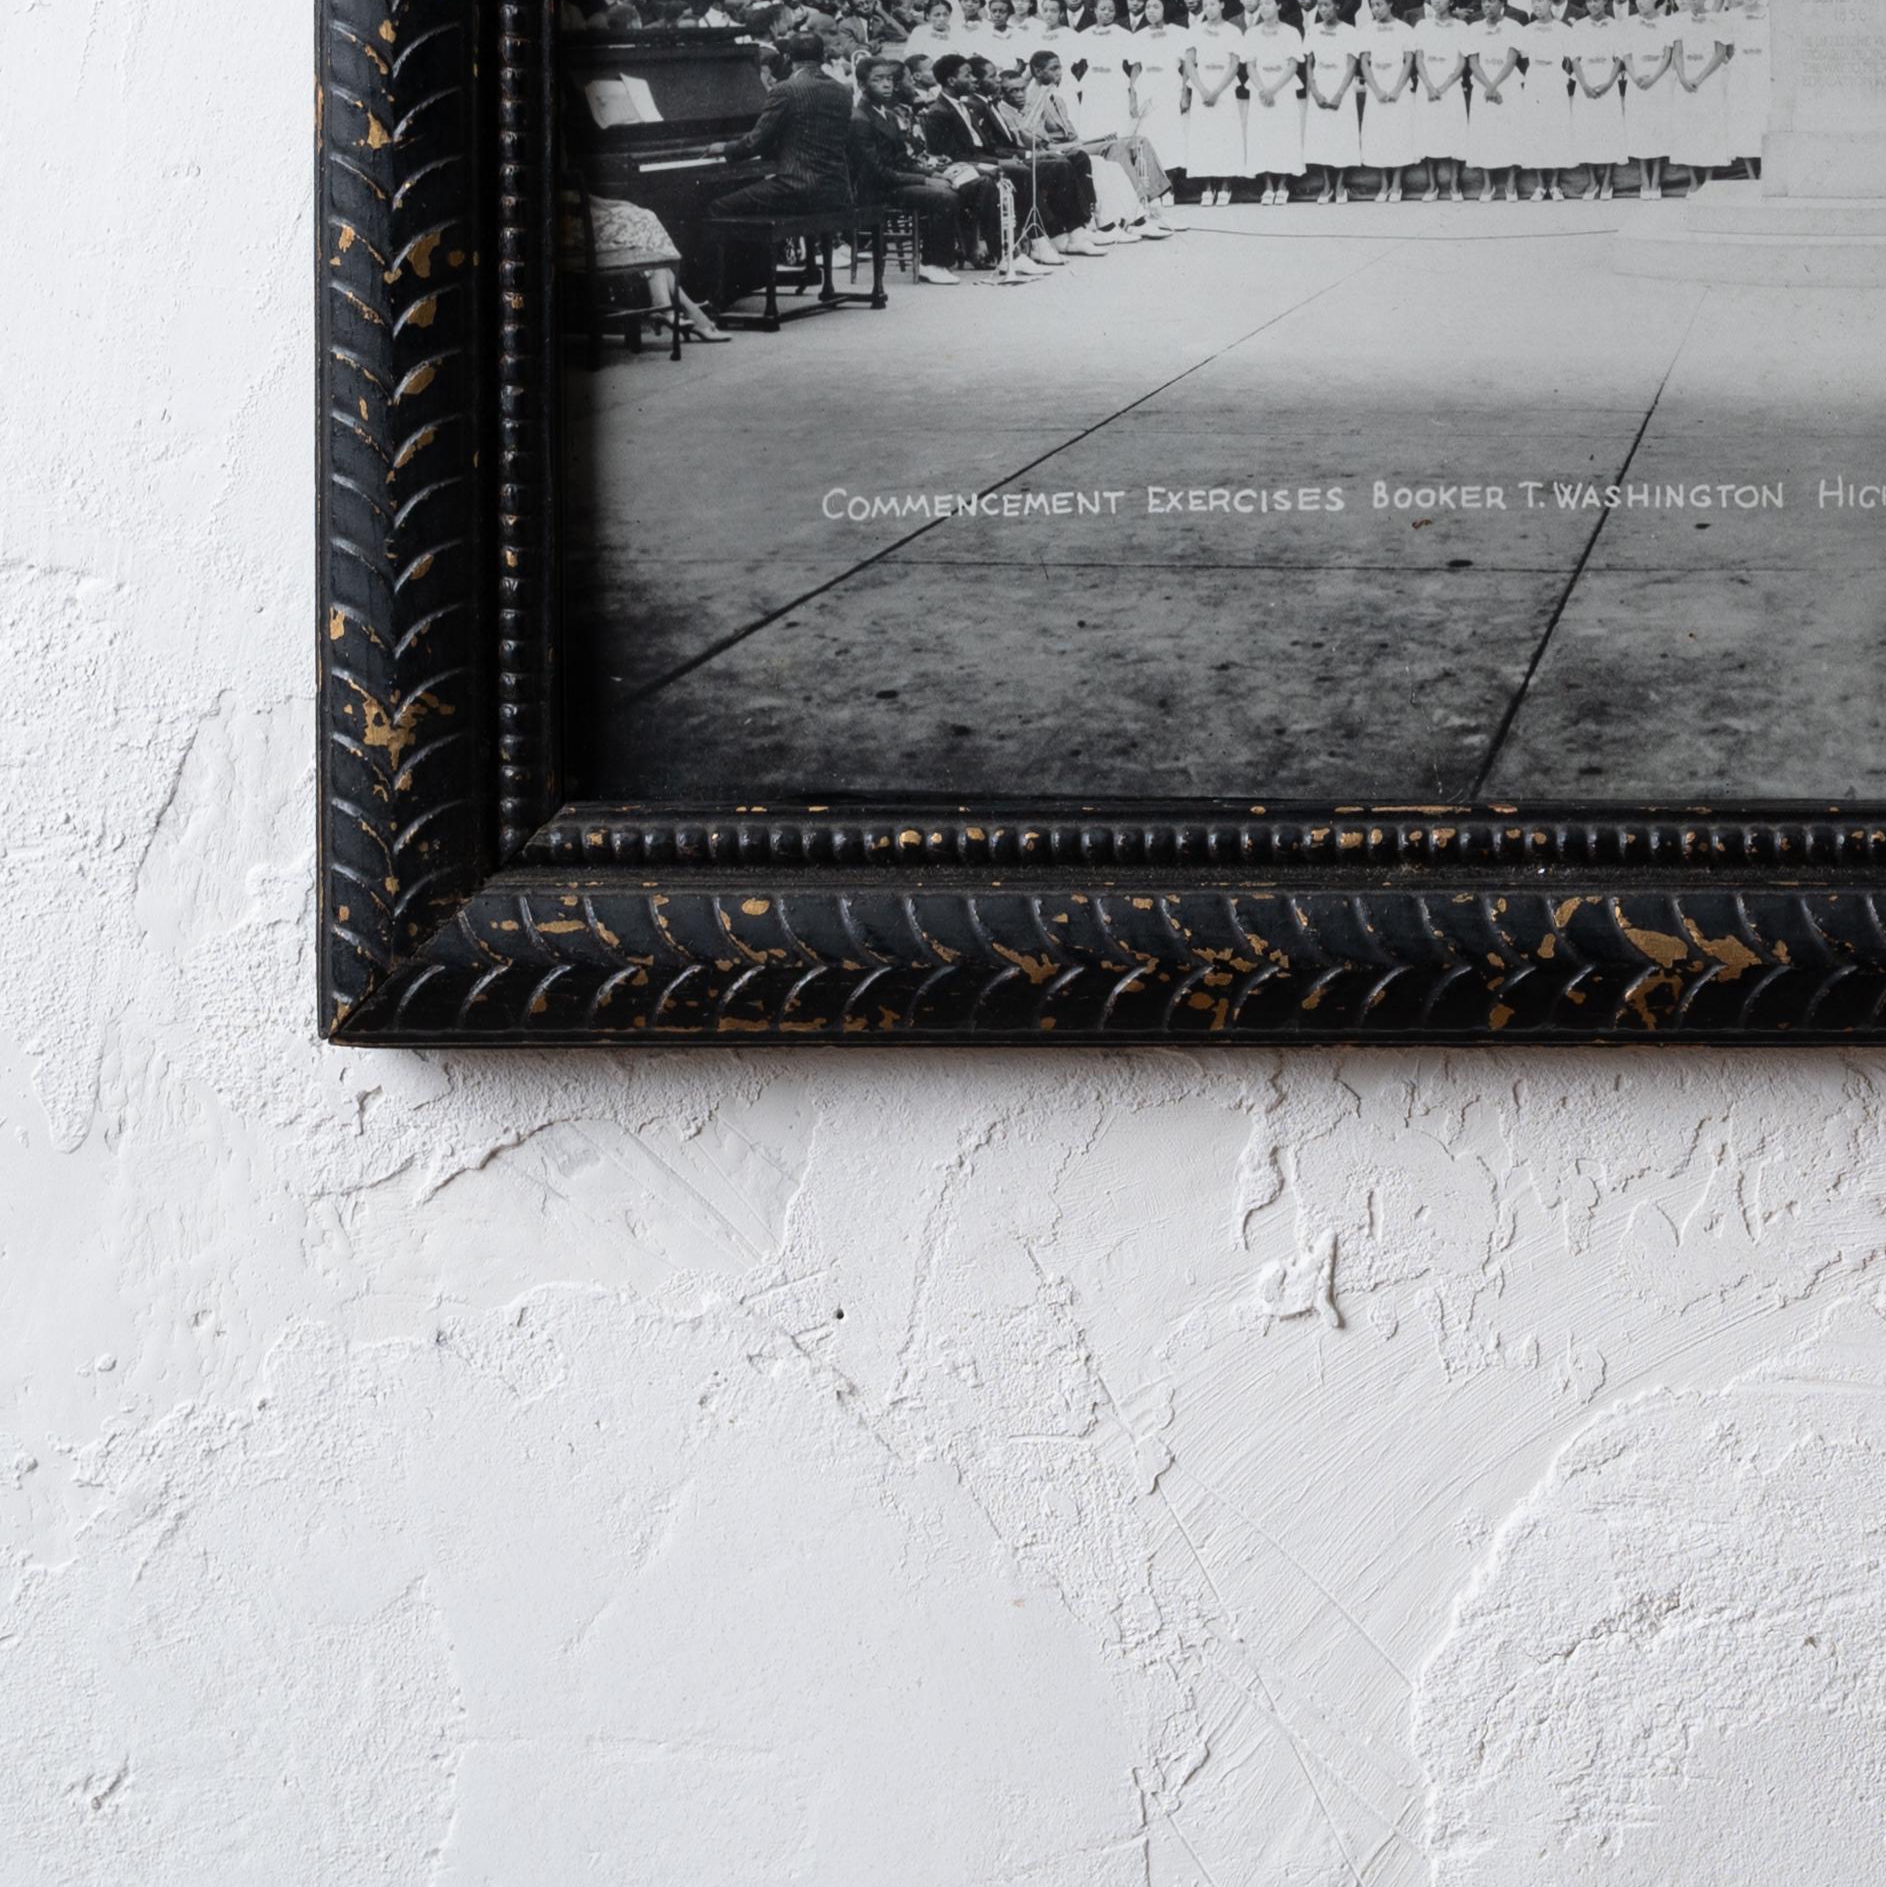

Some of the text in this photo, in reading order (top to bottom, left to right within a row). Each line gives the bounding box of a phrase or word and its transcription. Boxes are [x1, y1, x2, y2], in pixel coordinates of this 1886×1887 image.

[821, 486, 1126, 522] COMMENCEMENT
[1147, 485, 1347, 514] EXERCISES
[1372, 479, 1507, 511] BOOKER
